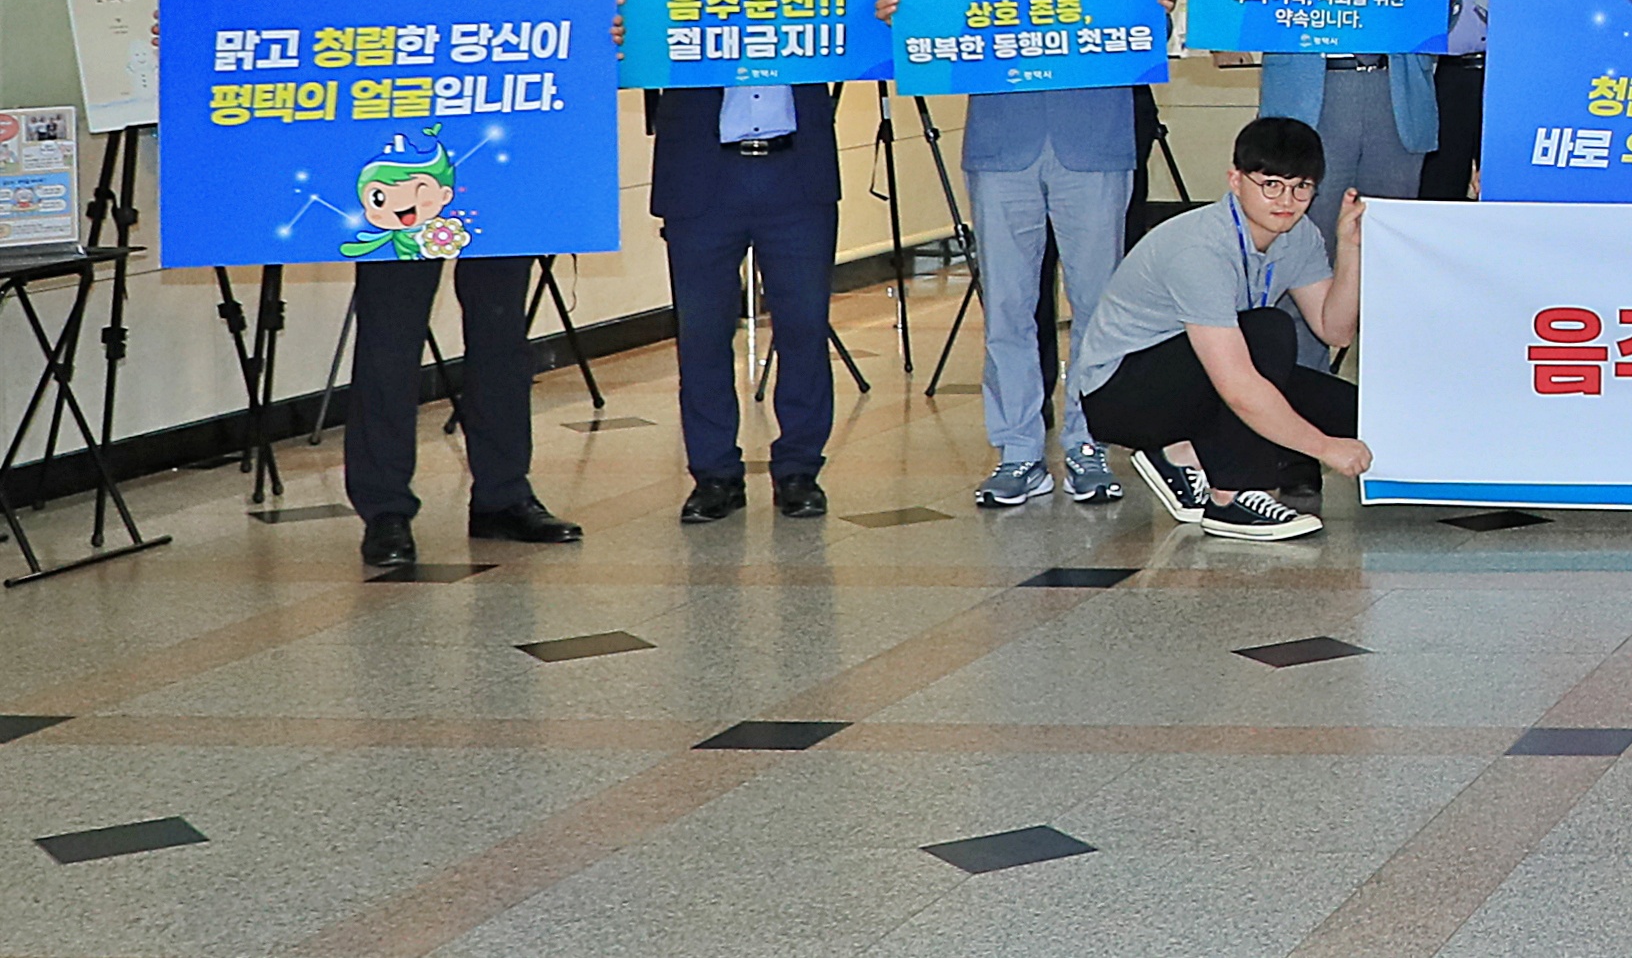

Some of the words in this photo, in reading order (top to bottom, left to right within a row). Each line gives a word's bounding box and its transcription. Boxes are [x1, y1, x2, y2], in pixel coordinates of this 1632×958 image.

[966, 0, 1019, 28] 상호
[1275, 9, 1363, 29] 약속입니다.
[214, 29, 300, 71] 맑고
[313, 25, 440, 68] 청렴한
[450, 21, 571, 62] 당신이
[666, 24, 846, 60] 절대금지!!
[906, 34, 985, 63] 행복한
[993, 30, 1069, 59] 동행의
[1077, 26, 1153, 55] 첫걸음
[1313, 36, 1338, 46] 평택시
[209, 81, 337, 125] 평택의
[350, 72, 565, 121] 얼굴입니다.
[1531, 127, 1612, 169] 바로
